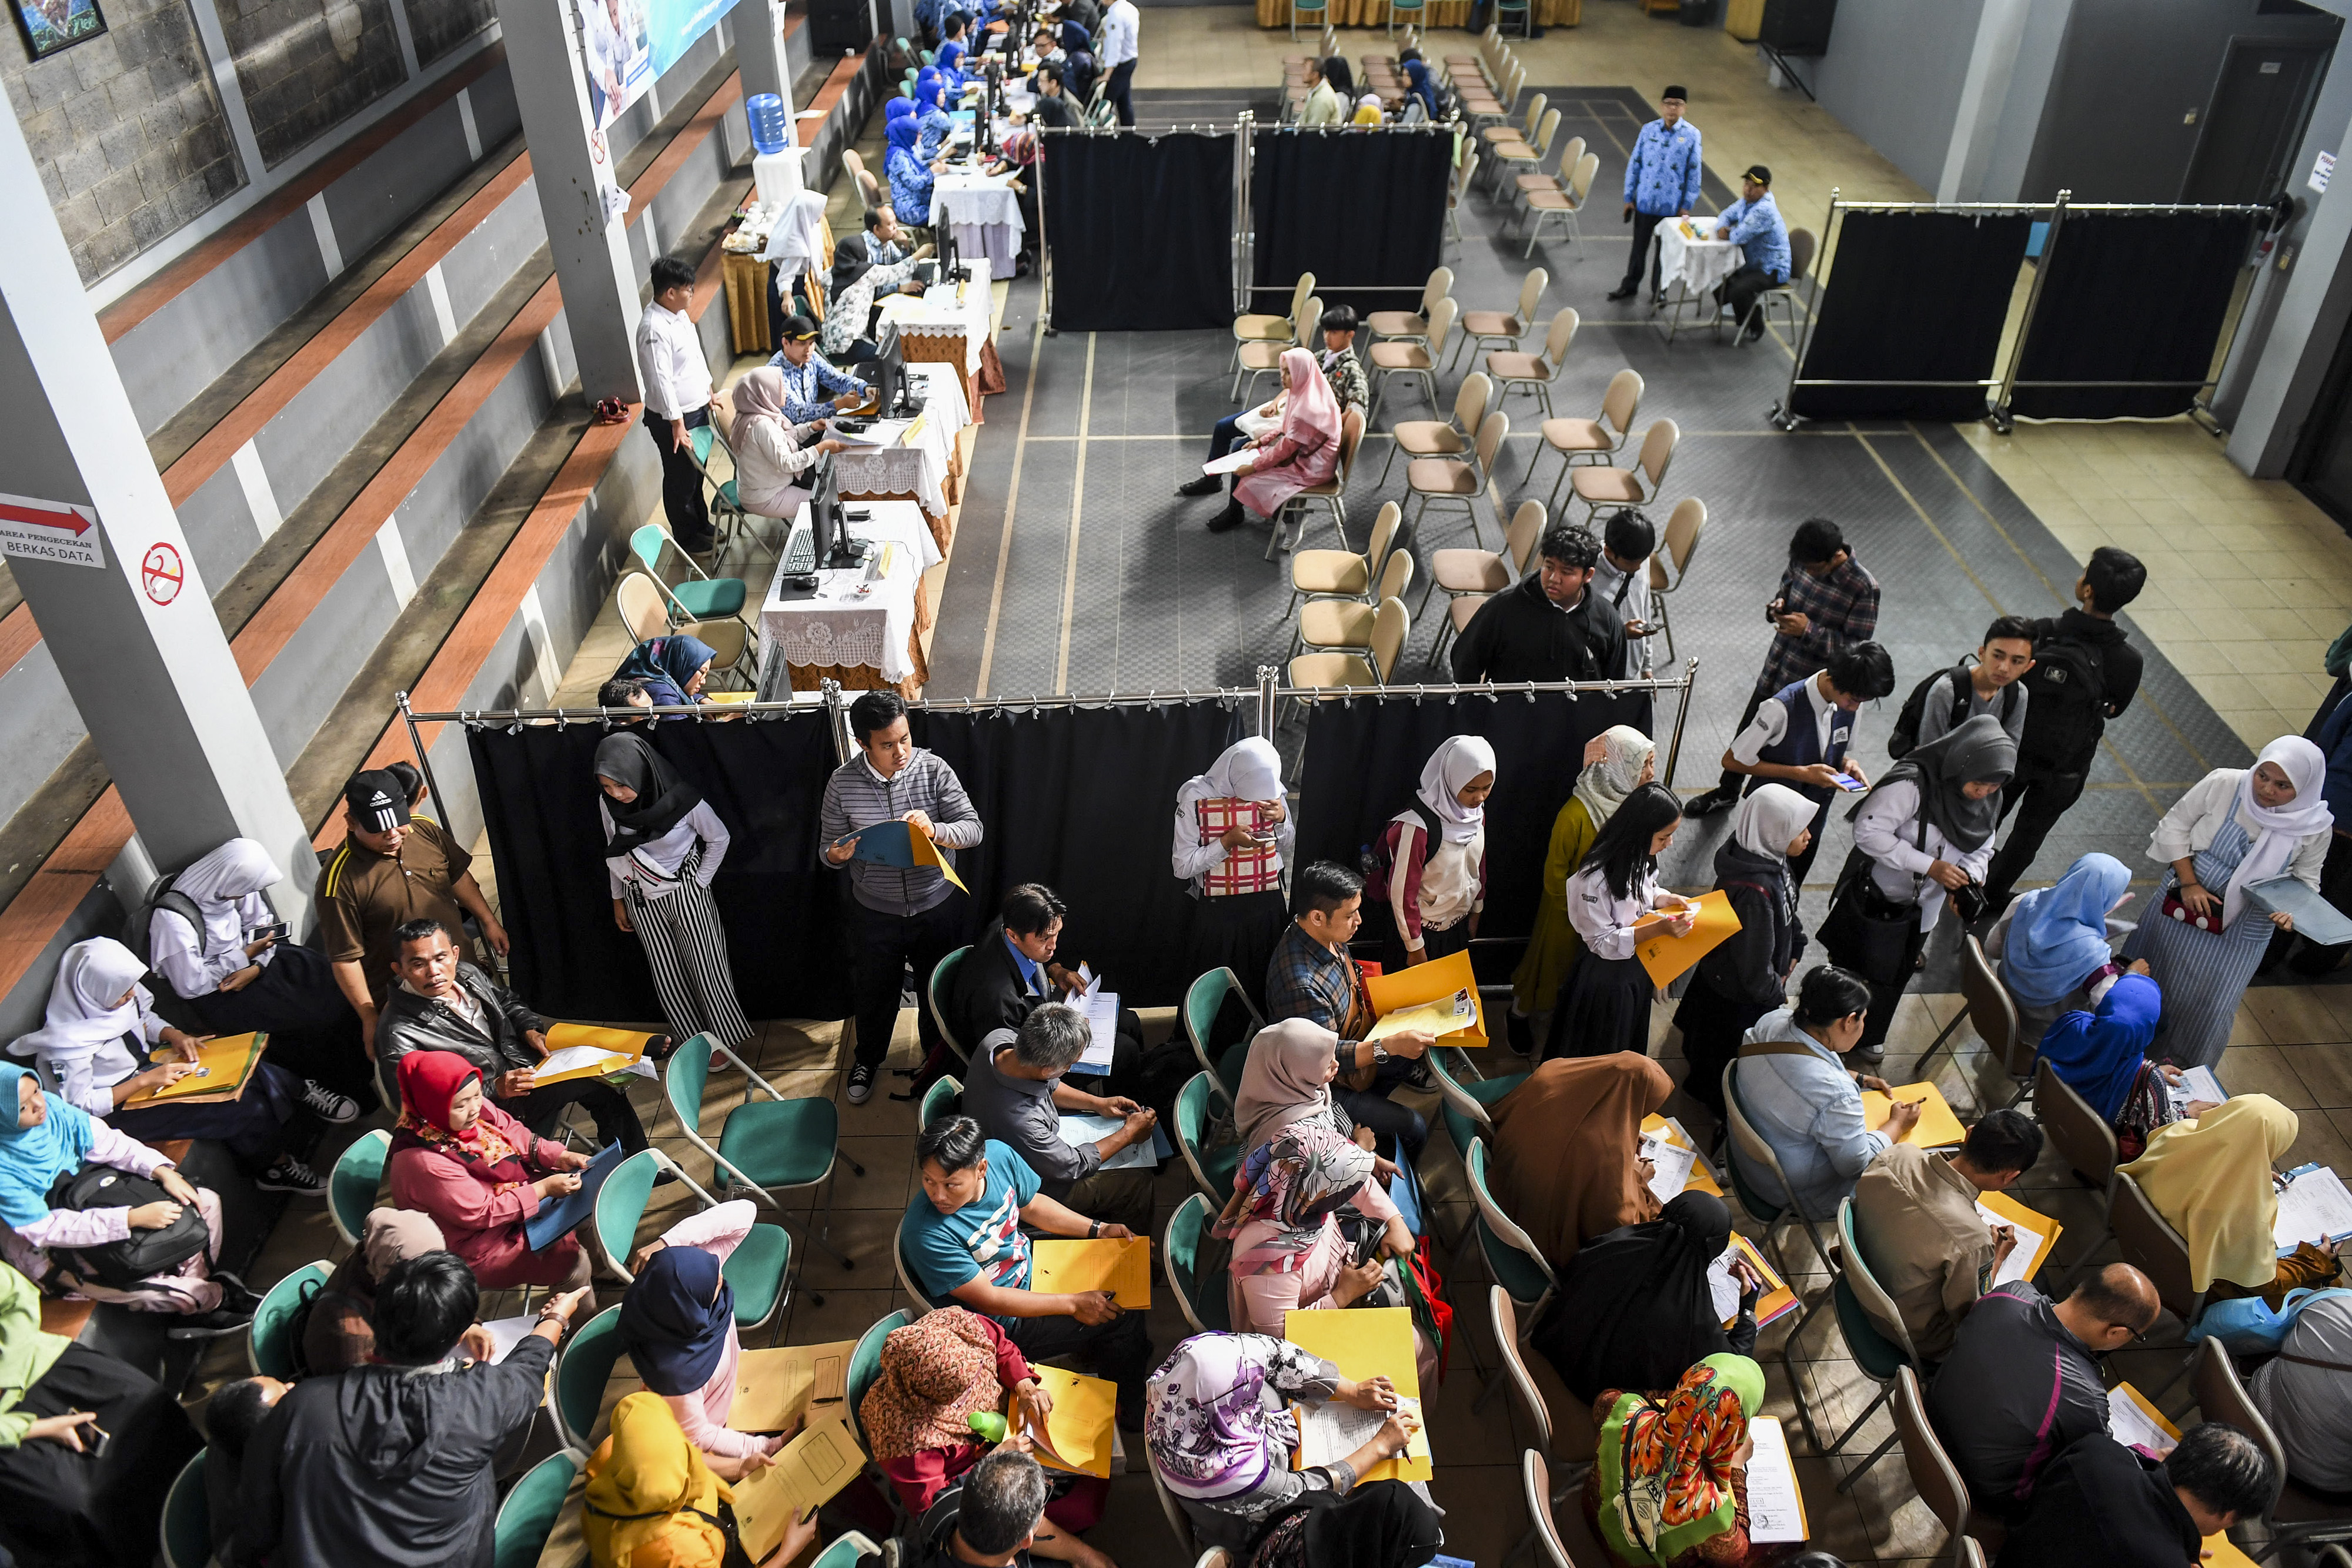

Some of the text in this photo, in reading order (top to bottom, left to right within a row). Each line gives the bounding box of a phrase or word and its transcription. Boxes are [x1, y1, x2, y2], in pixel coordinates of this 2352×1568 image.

[0, 530, 92, 549] AREA PENGECEKAN
[7, 541, 93, 563] BERKAS DATA
[369, 798, 393, 807] adidas
